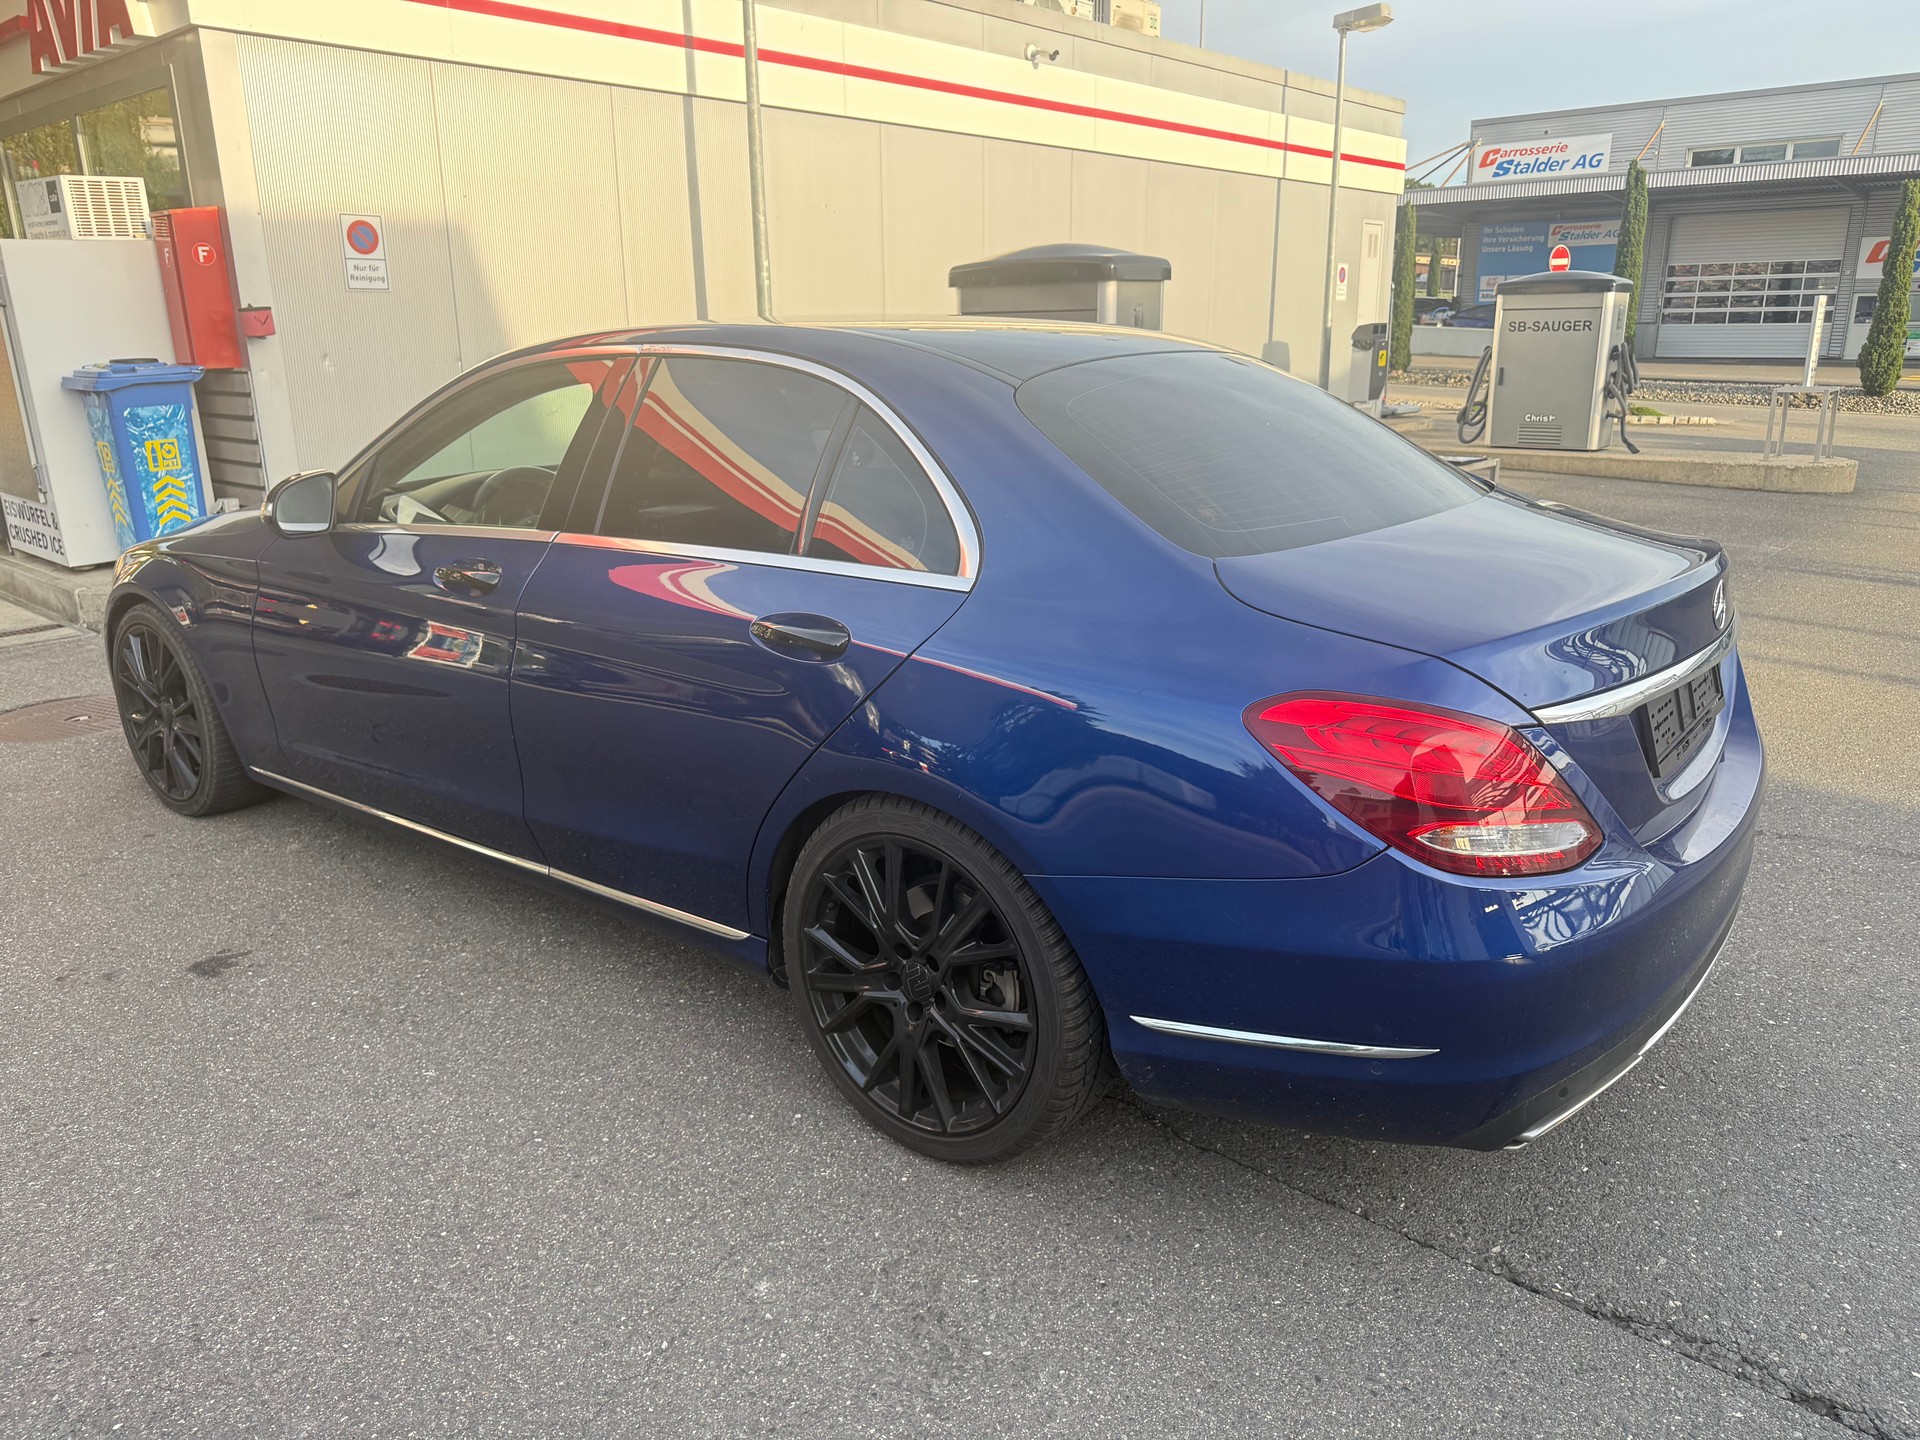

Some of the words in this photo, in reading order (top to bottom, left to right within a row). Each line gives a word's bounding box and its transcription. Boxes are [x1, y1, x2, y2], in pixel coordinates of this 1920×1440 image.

[27, 0, 135, 74] AVIA
[1478, 142, 1569, 168] Carrosserie
[1491, 156, 1569, 178] Stalder
[1571, 152, 1605, 170] AG
[1483, 226, 1493, 234] Ihr
[1494, 226, 1525, 234] Schaden
[1550, 223, 1602, 236] Carrosserie
[1497, 235, 1545, 243] Versicherung
[1558, 230, 1602, 241] Stalder
[197, 246, 210, 263] F
[1507, 245, 1534, 253] Lösung
[353, 264, 367, 272] Nur
[368, 264, 379, 272] für
[350, 274, 386, 283] Reinigung
[1508, 320, 1593, 332] SB-SAUGER
[1524, 413, 1556, 422] Christ
[163, 458, 178, 467] PET
[4, 499, 51, 528] EISWÜRFEL
[50, 511, 59, 531] &
[9, 523, 49, 550] CRUSHED
[49, 534, 65, 556] ICE
